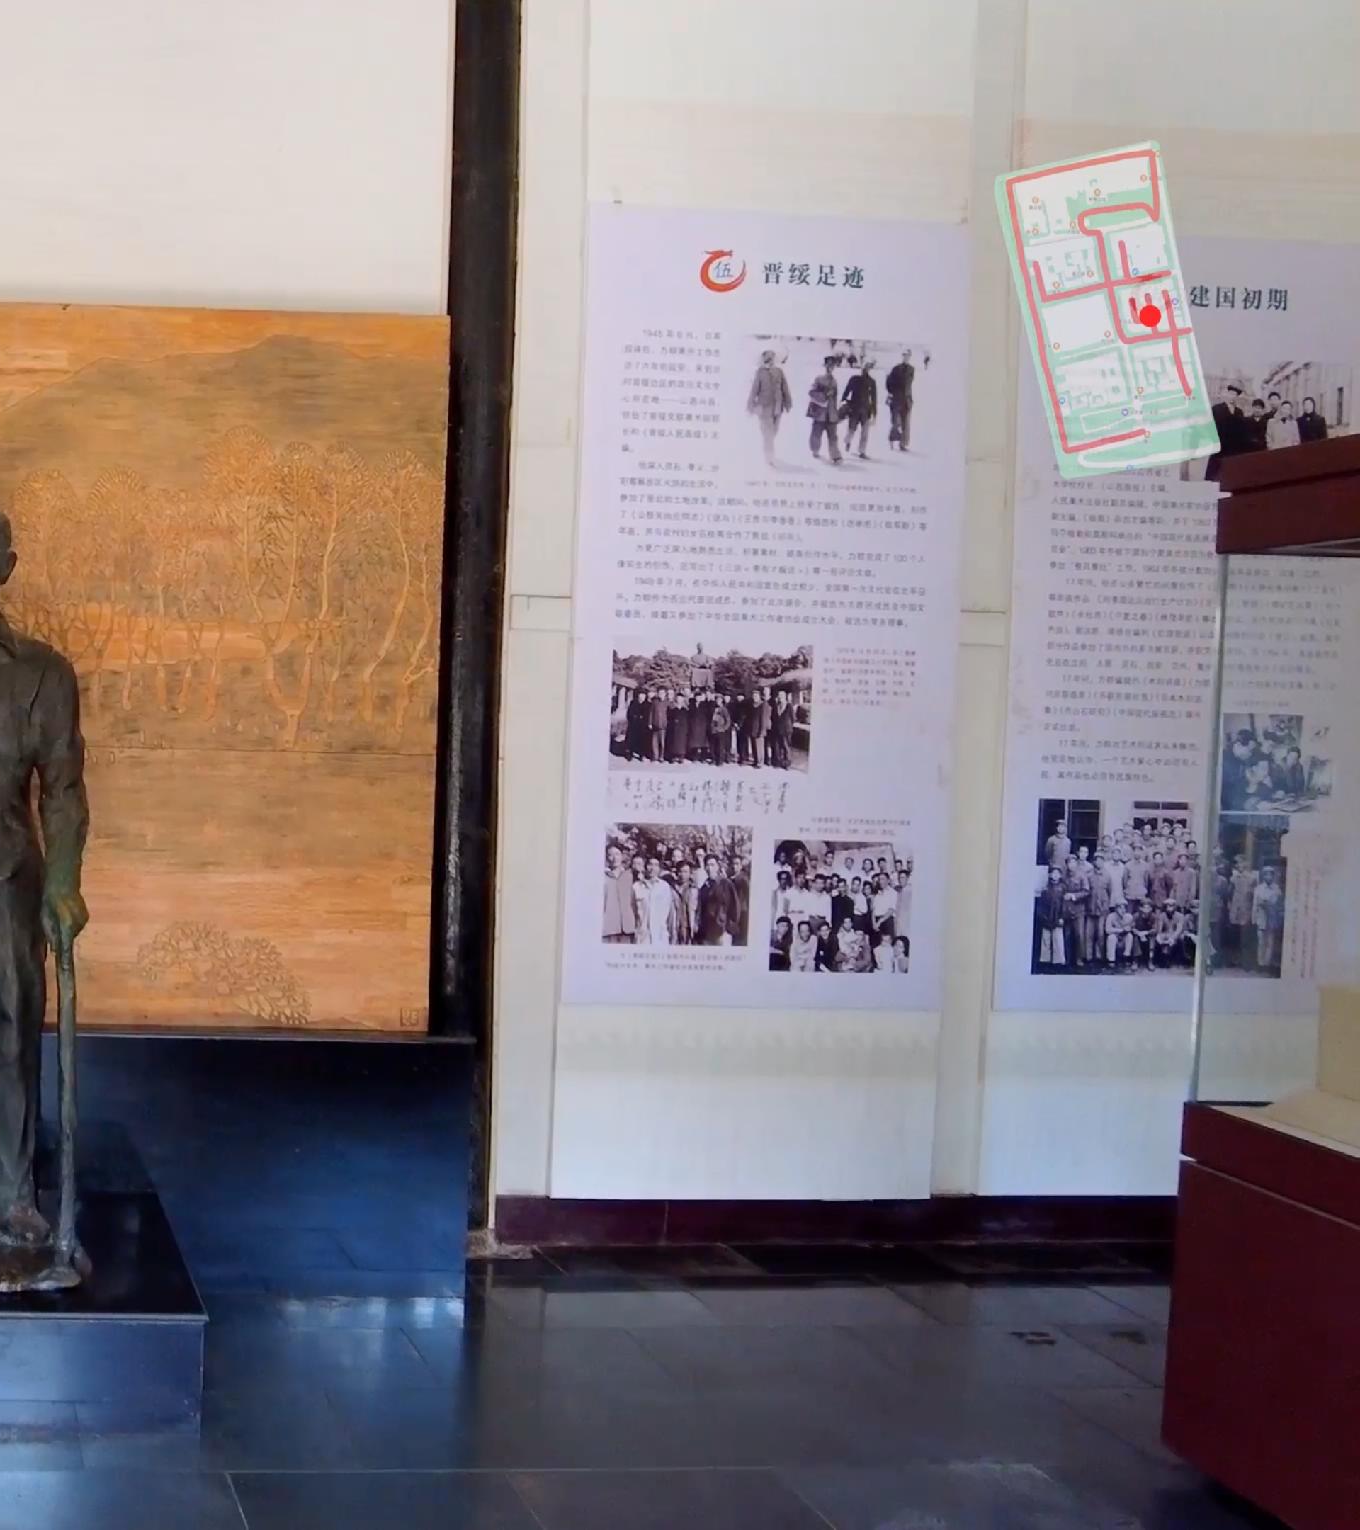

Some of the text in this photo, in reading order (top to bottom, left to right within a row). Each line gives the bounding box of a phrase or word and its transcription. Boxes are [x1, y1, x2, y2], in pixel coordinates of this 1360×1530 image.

[714, 260, 865, 289] 伍 晋绥足迹
[1190, 285, 1288, 311] 建国初期
